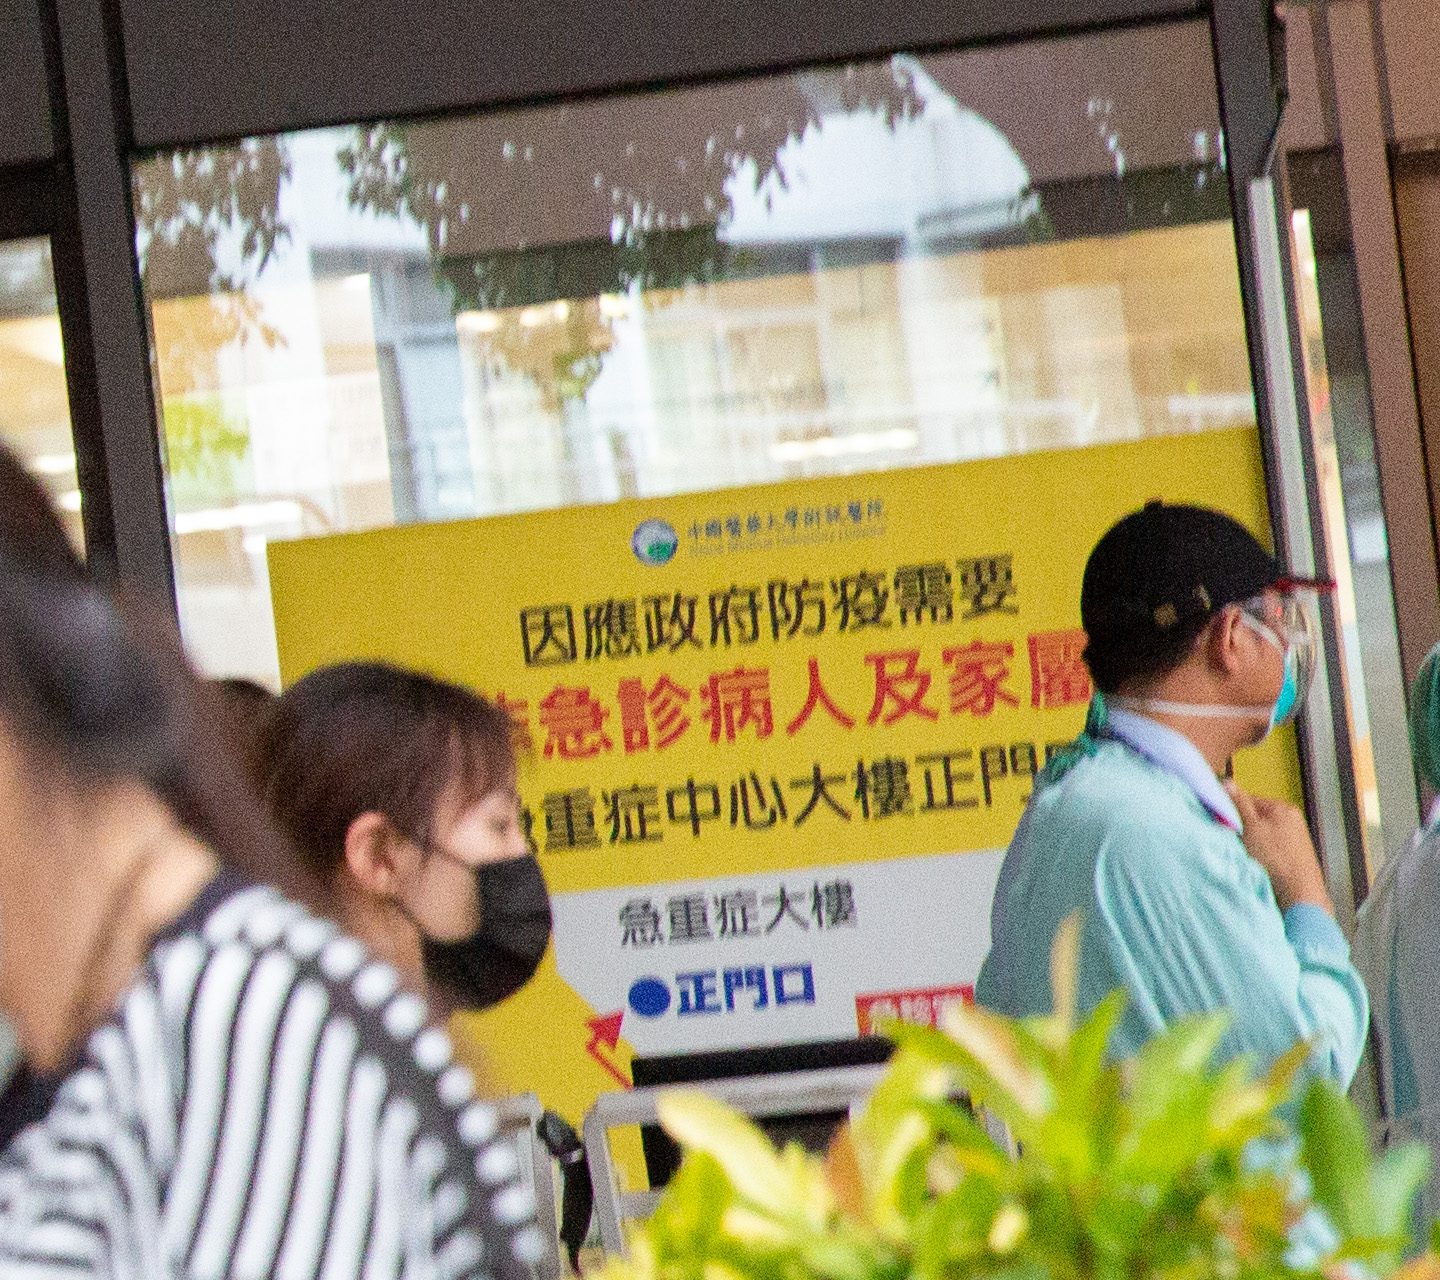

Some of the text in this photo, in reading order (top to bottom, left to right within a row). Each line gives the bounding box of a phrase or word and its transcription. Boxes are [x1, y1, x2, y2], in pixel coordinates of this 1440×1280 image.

[518, 552, 1021, 668] 因應政府防疫需要
[482, 627, 1093, 761] 急診病人及家屬
[521, 739, 1082, 856] 重症中心大樓正門
[618, 876, 857, 948] 急重症大樓
[675, 960, 816, 1018] 正門口
